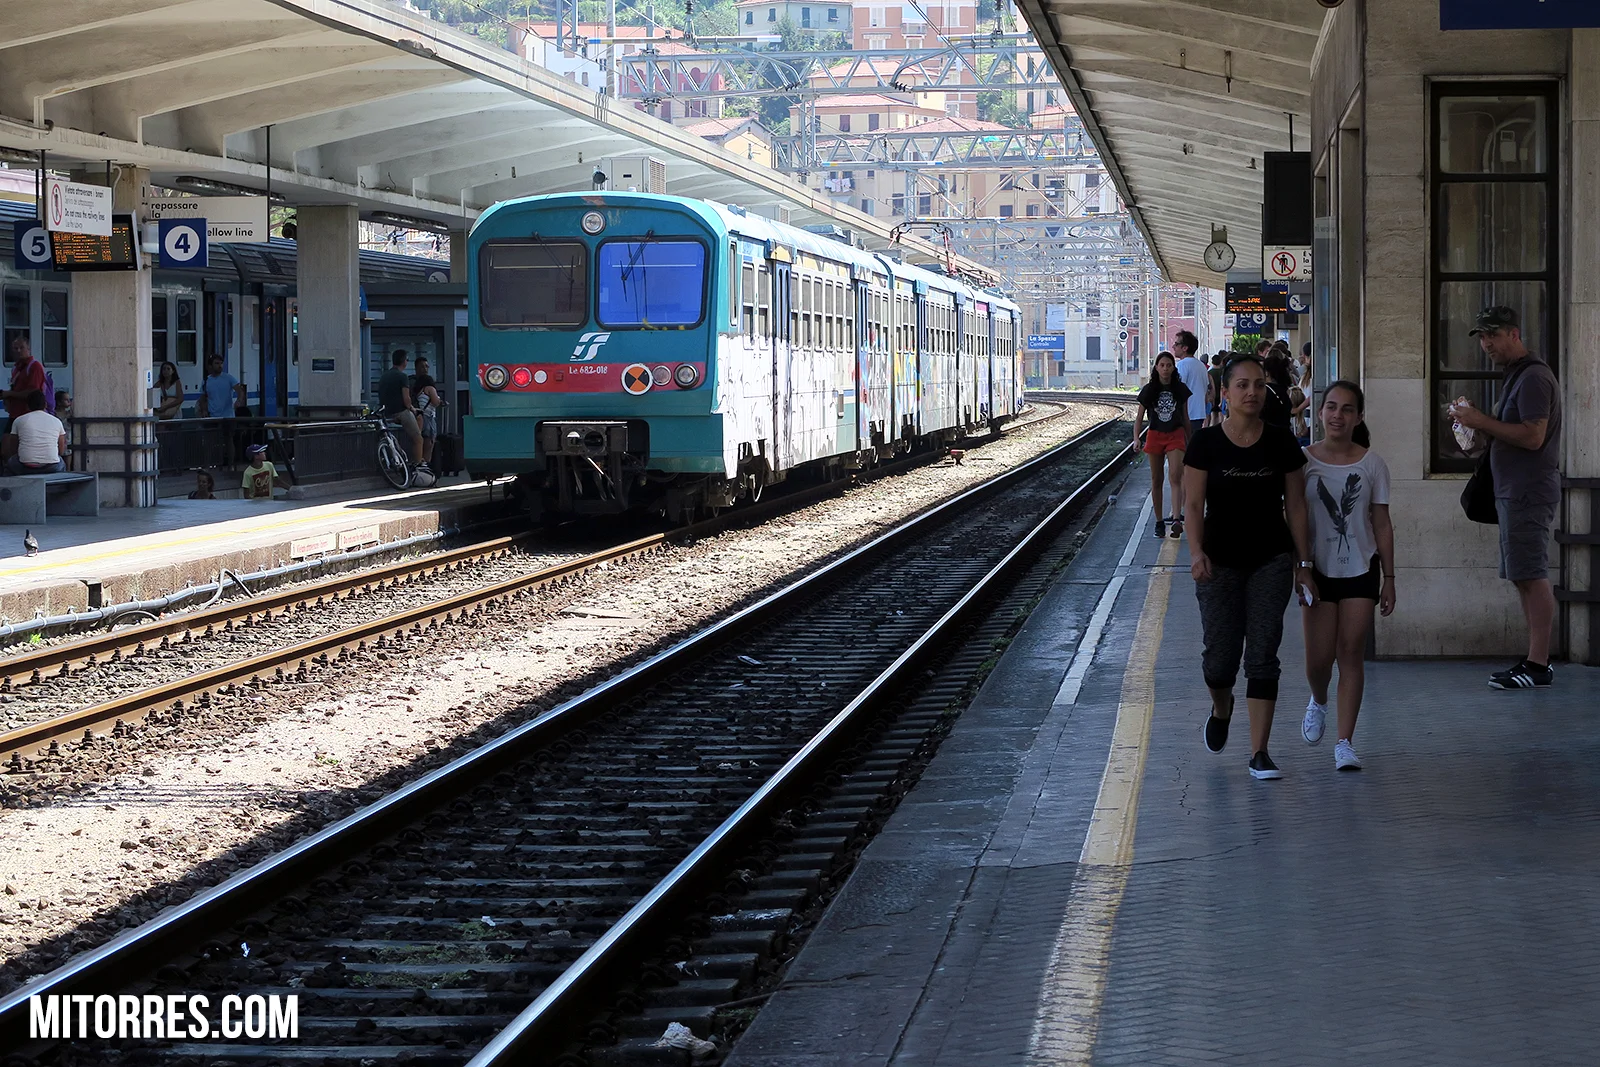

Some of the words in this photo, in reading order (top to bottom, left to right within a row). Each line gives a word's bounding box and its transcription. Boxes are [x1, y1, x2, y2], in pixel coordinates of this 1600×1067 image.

[235, 228, 253, 236] line
[31, 235, 46, 257] 5
[174, 233, 191, 254] 4
[1256, 313, 1263, 322] 3
